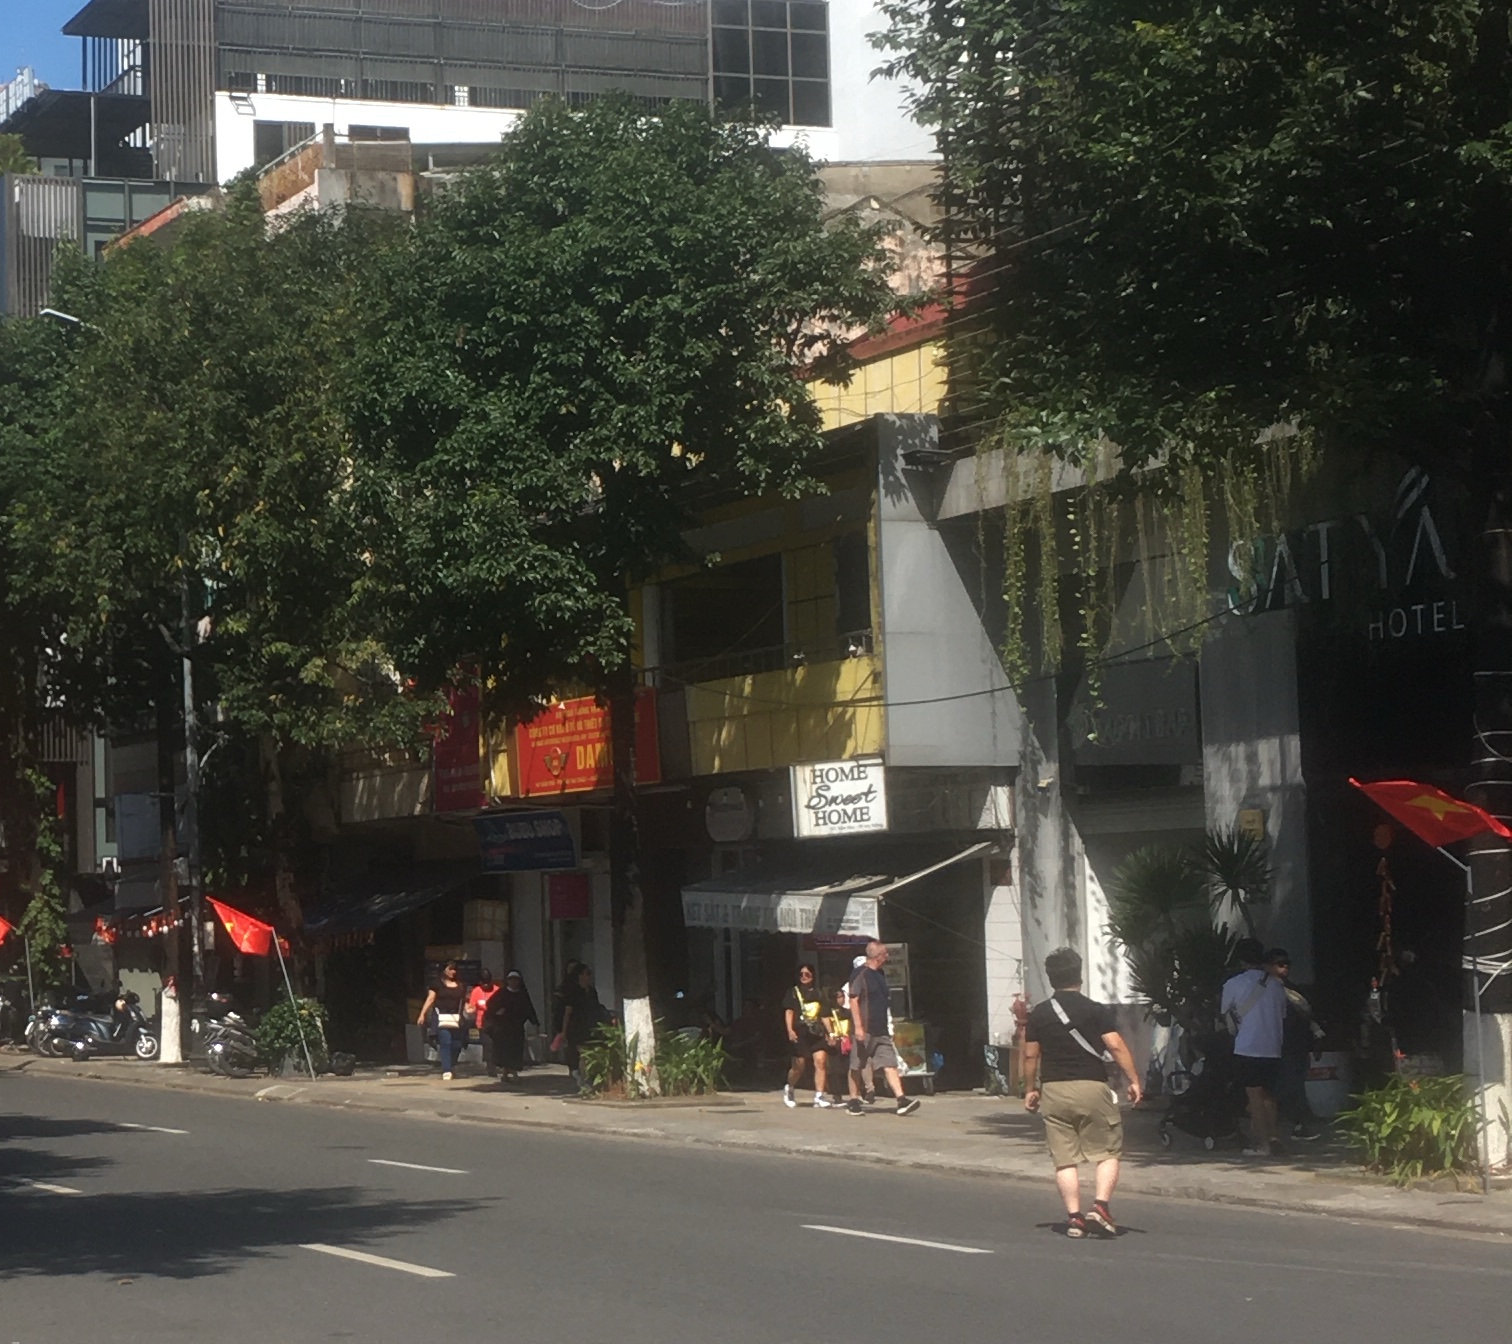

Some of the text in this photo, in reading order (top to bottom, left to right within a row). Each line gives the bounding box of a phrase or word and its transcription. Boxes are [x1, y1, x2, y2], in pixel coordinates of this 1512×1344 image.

[1368, 599, 1465, 640] HOTEL
[810, 765, 869, 785] HOME
[804, 783, 878, 811] Sweet
[813, 806, 872, 827] HOME
